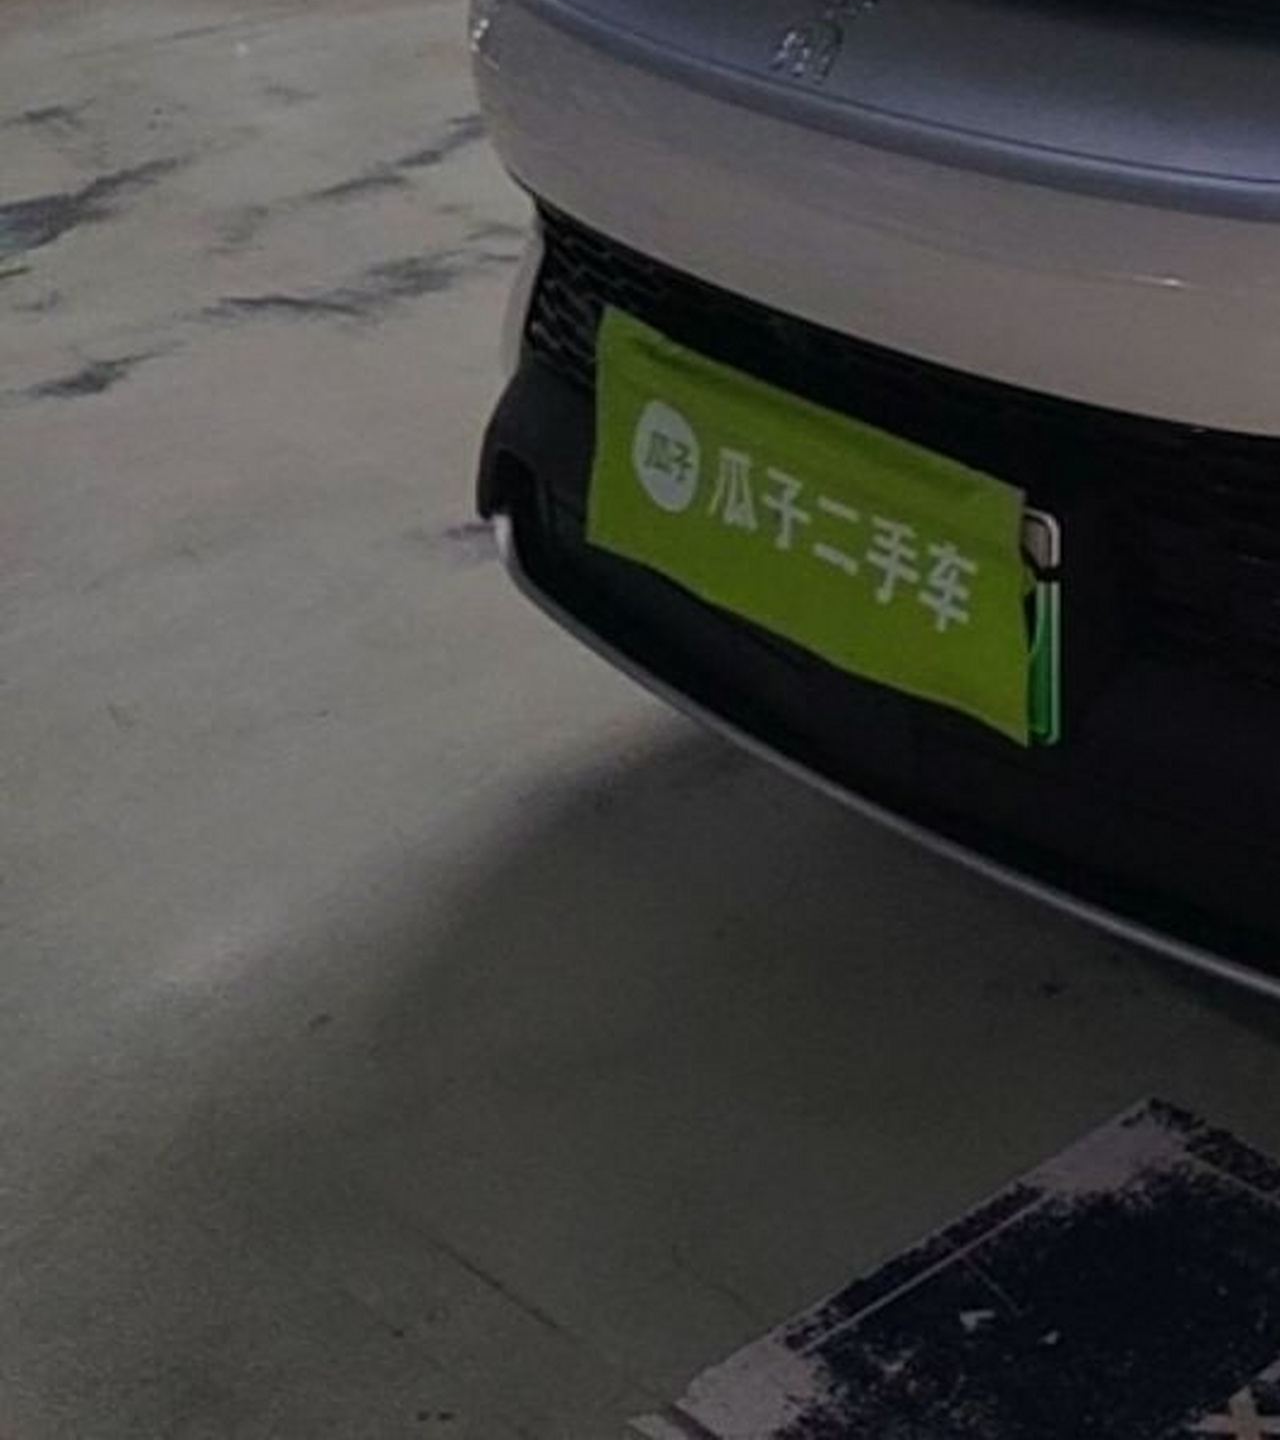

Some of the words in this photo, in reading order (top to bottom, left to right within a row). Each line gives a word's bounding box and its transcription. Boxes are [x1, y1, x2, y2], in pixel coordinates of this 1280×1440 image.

[706, 446, 977, 633] 瓜子二手车
